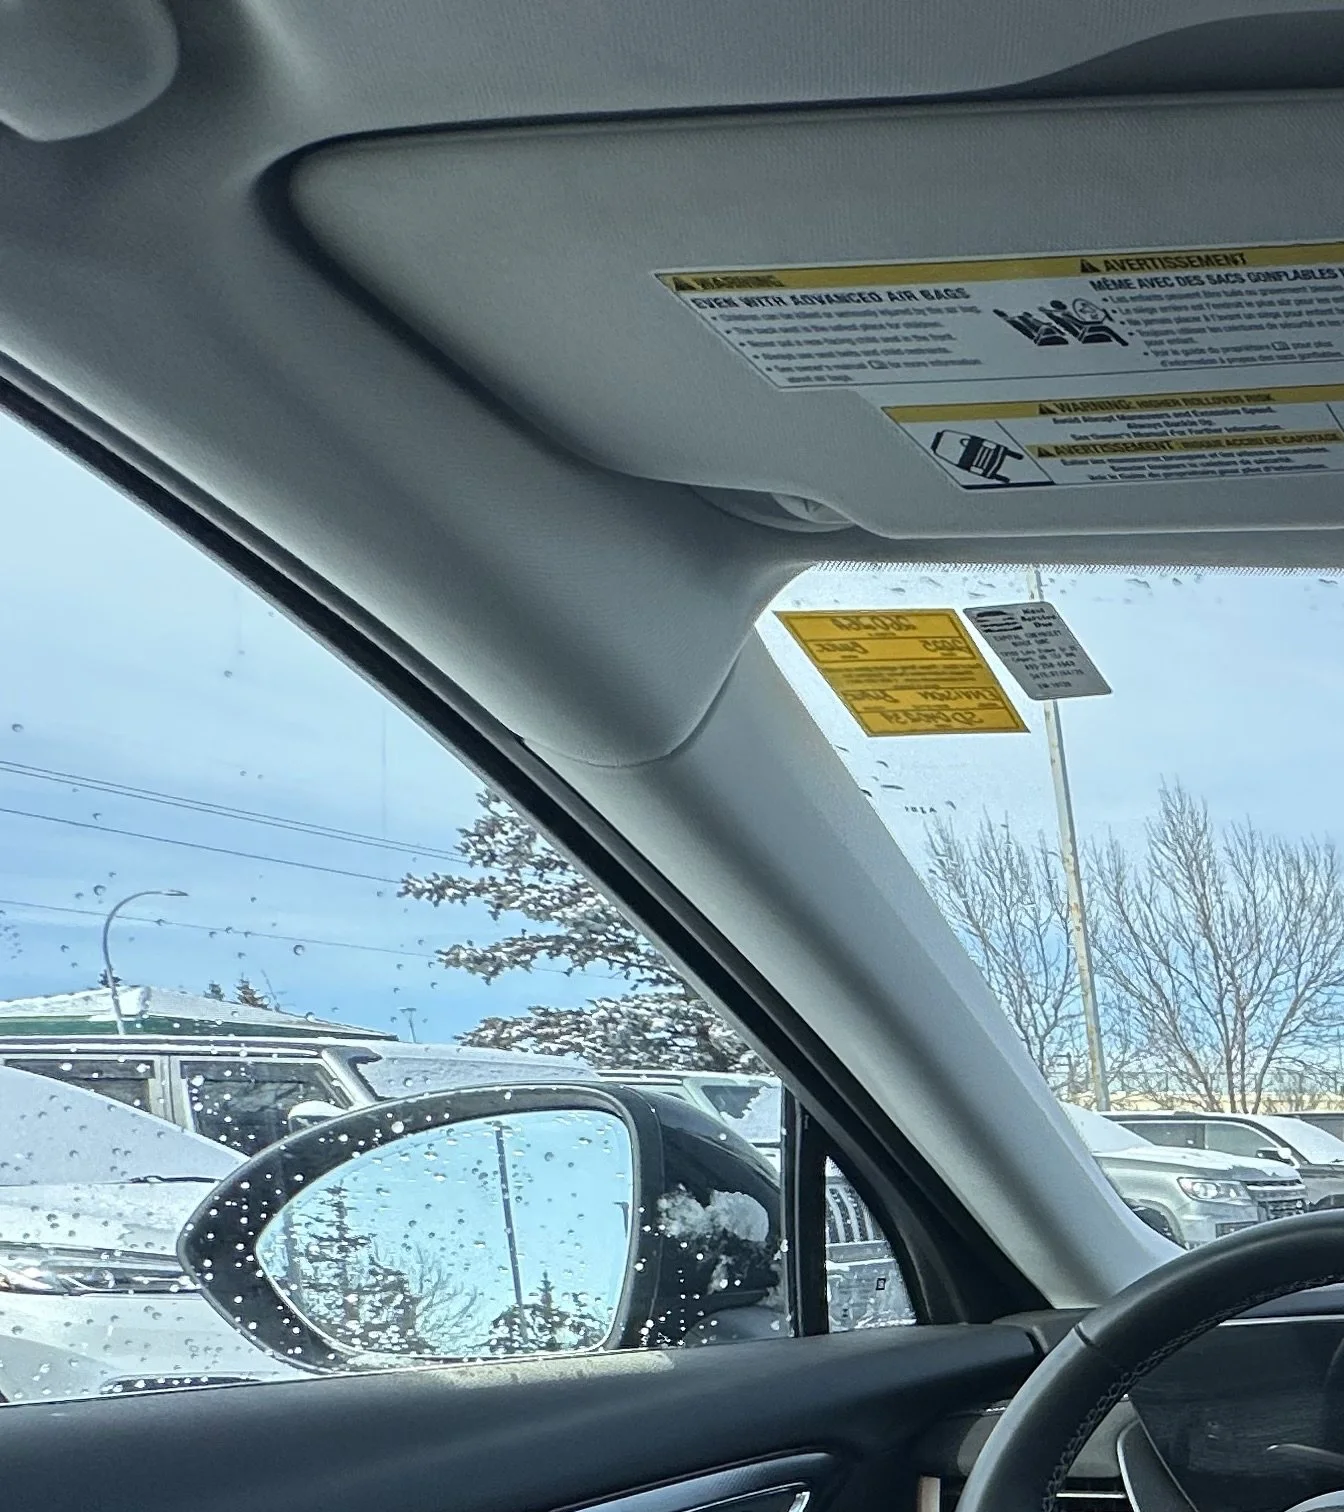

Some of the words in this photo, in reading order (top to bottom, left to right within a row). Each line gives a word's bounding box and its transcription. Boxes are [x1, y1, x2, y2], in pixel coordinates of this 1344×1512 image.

[1102, 252, 1249, 273] AVERTISSEMENT
[1136, 274, 1175, 290] AVEC
[1174, 274, 1206, 287] DES
[1206, 272, 1247, 286] SACS
[1246, 267, 1339, 283] GONFLABLES
[690, 296, 736, 310] EVEN
[741, 294, 785, 308] WITH
[790, 290, 883, 307] ADVANCED
[887, 289, 919, 304] AIR
[920, 286, 971, 302] BAGS
